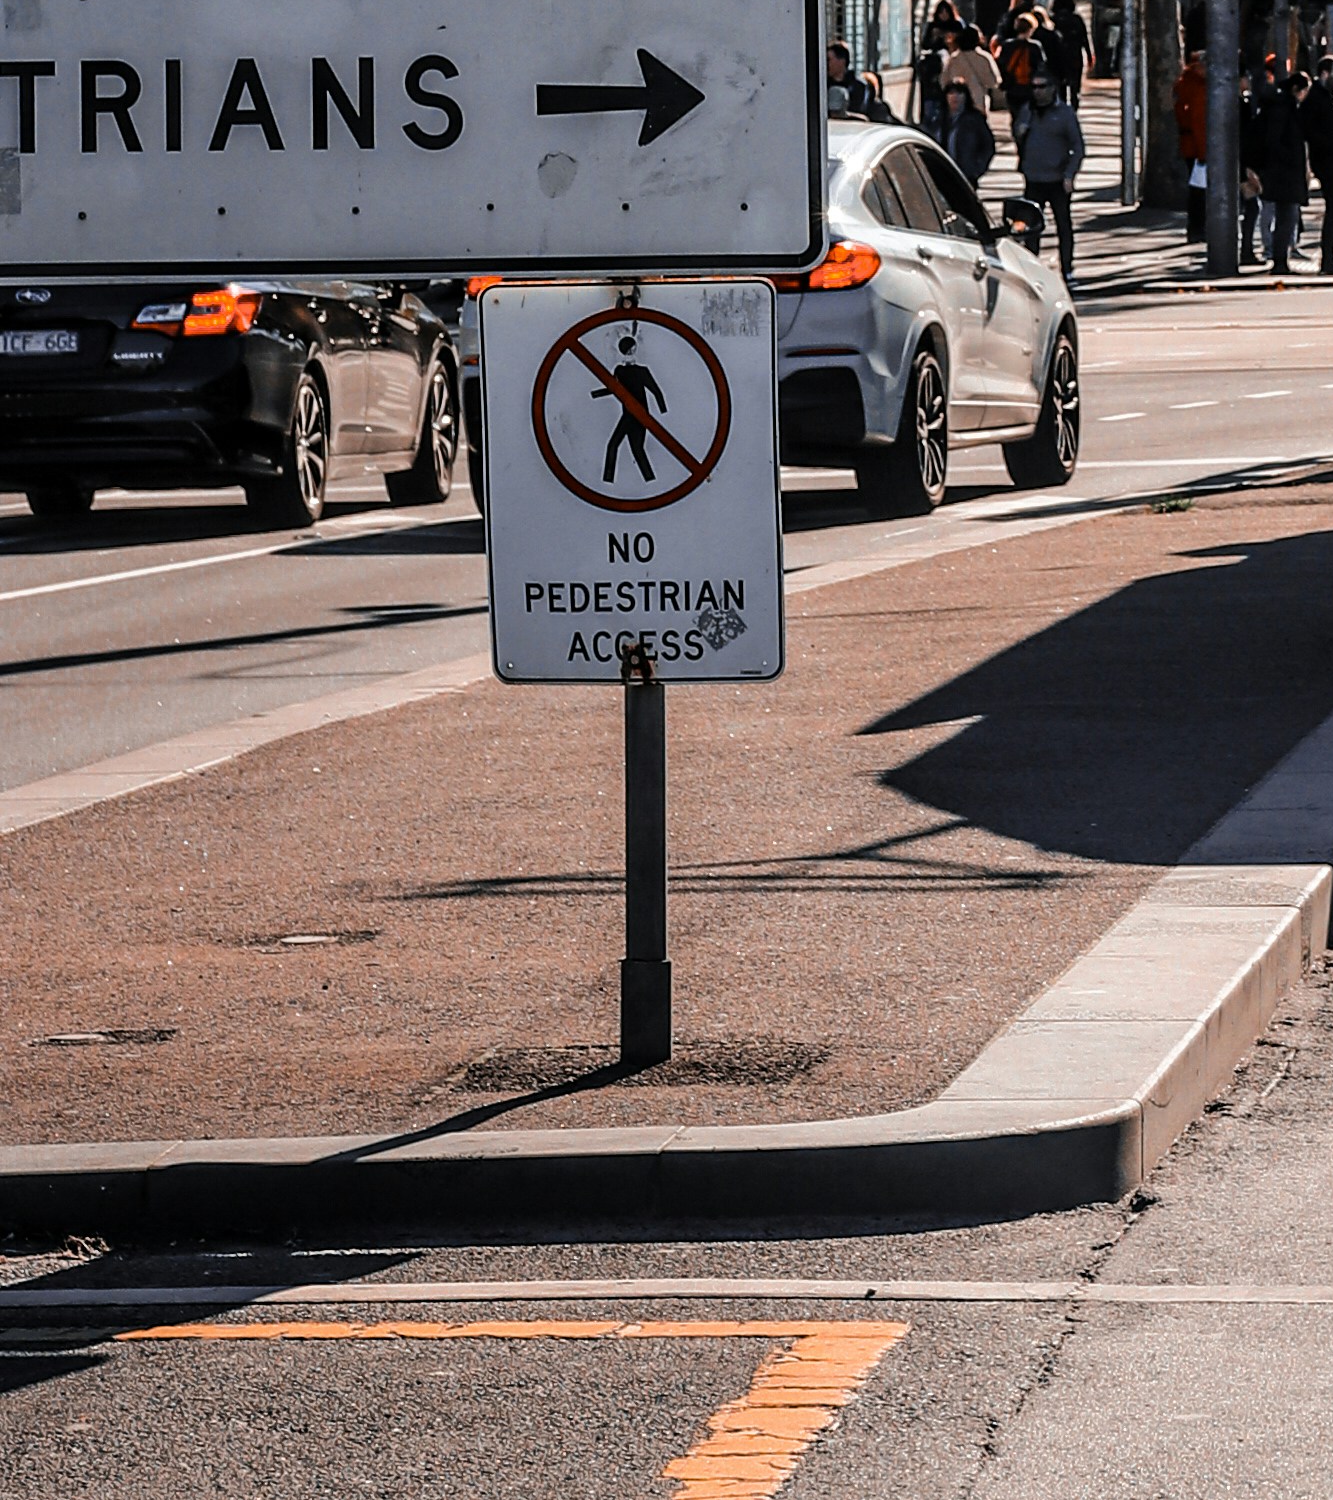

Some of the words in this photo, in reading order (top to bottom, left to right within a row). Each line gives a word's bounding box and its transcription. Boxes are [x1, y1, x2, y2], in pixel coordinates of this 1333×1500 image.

[0, 53, 465, 155] TRIANS
[608, 532, 655, 564] NO
[524, 578, 745, 613] PEDESTRIAN
[567, 630, 704, 662] ACCESS
